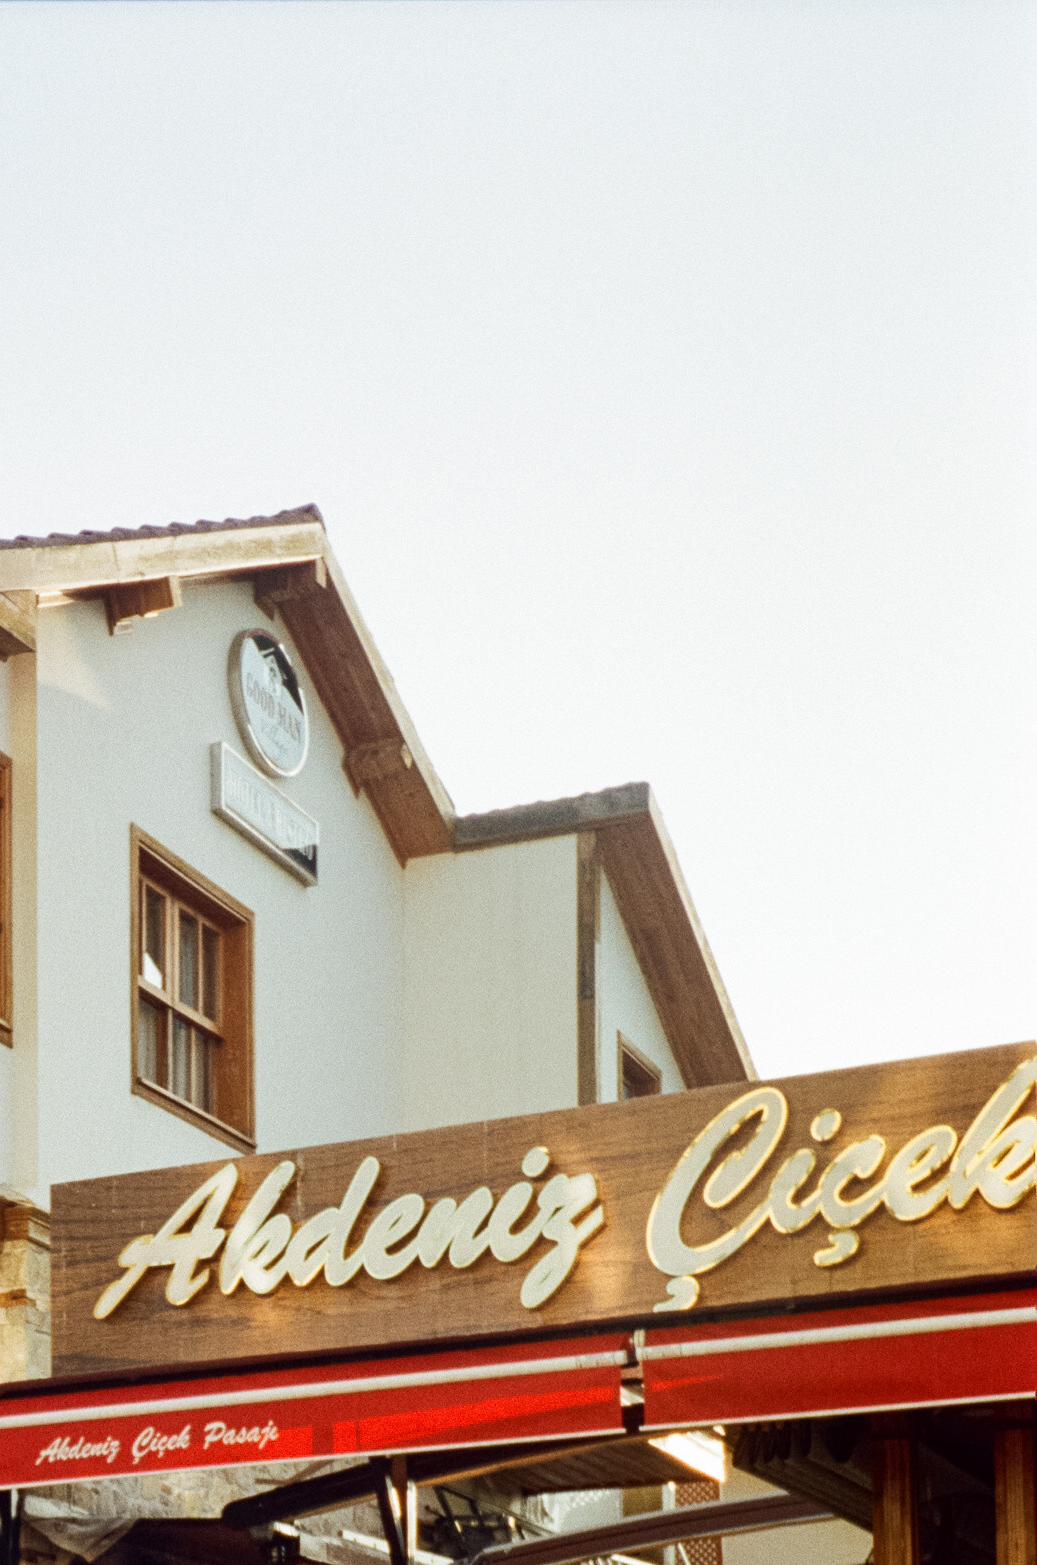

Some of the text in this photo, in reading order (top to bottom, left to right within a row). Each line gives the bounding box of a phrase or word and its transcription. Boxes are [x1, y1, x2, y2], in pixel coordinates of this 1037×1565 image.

[93, 1057, 1037, 1321] Akdeniz Çiçek
[35, 1419, 280, 1466] Akdeniz Çiçek Pasajı
